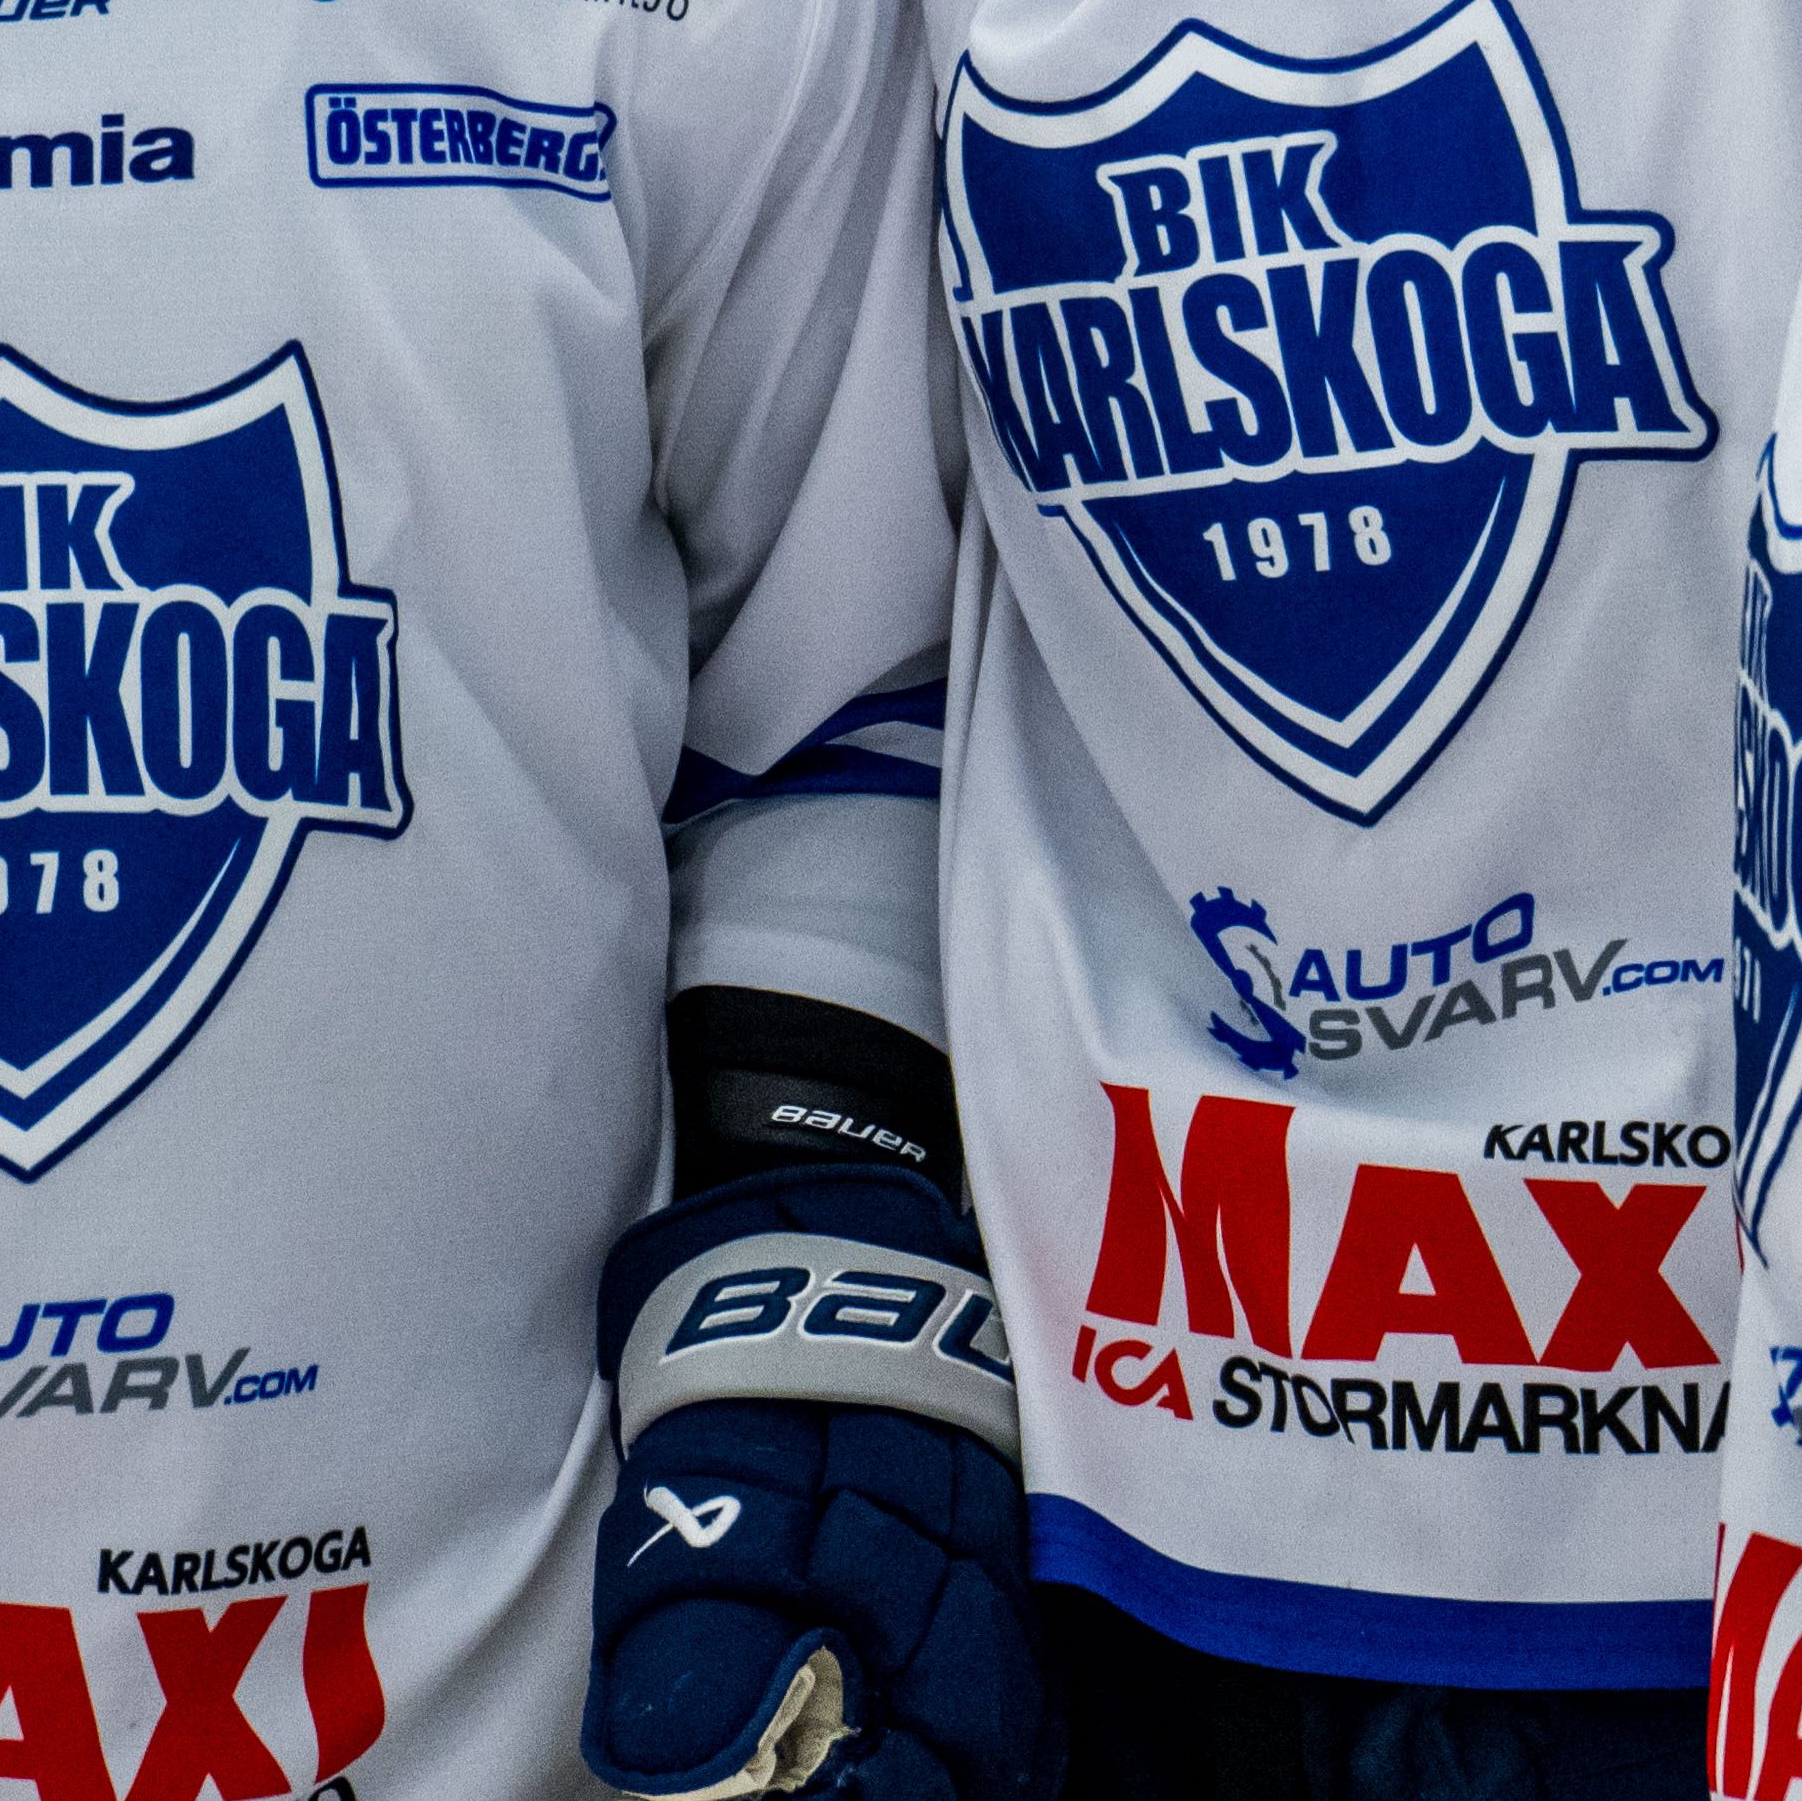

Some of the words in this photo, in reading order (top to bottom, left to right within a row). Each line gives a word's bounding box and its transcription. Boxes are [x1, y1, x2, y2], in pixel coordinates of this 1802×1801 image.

[325, 96, 607, 183] ÖSTERBERG
[1108, 139, 1339, 278] BIK
[1203, 505, 1393, 582] 1978
[1289, 893, 1536, 1002] AUTO
[772, 1104, 927, 1163] BAUER
[1072, 1325, 1193, 1421] ICA
[98, 1527, 371, 1596] KARLSKOGA
